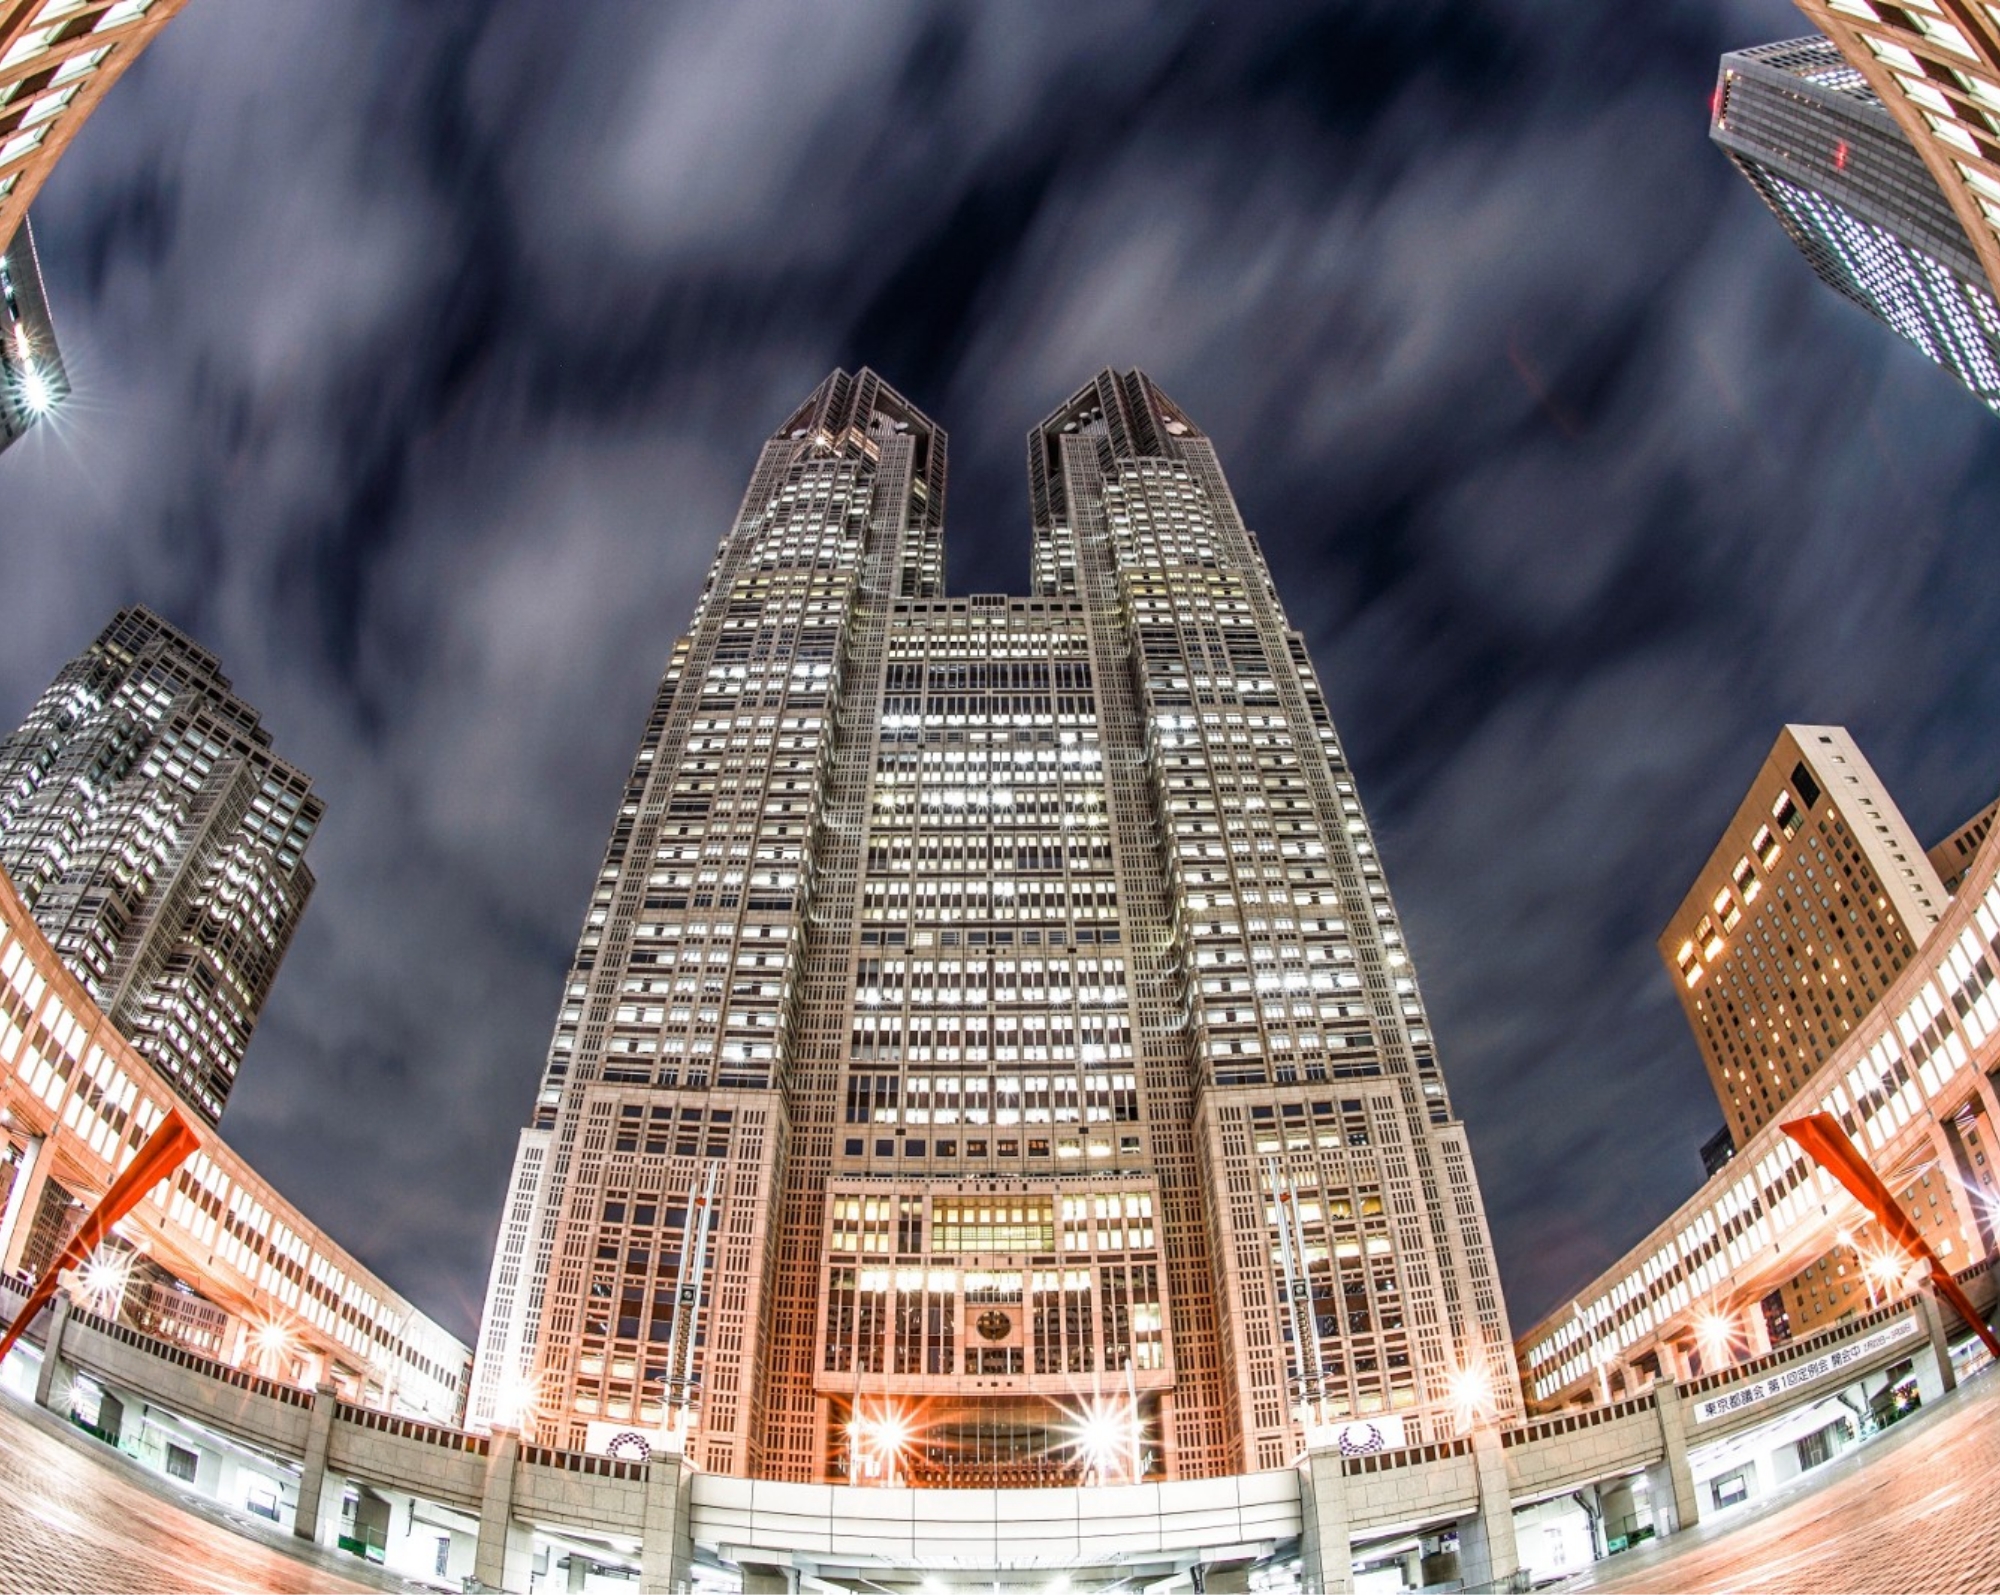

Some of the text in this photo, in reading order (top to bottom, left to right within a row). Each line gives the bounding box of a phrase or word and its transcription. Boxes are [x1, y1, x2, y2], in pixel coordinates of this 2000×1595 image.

[1705, 1386, 1766, 1417] 東京都議会
[1768, 1361, 1830, 1394] 第1回定例会
